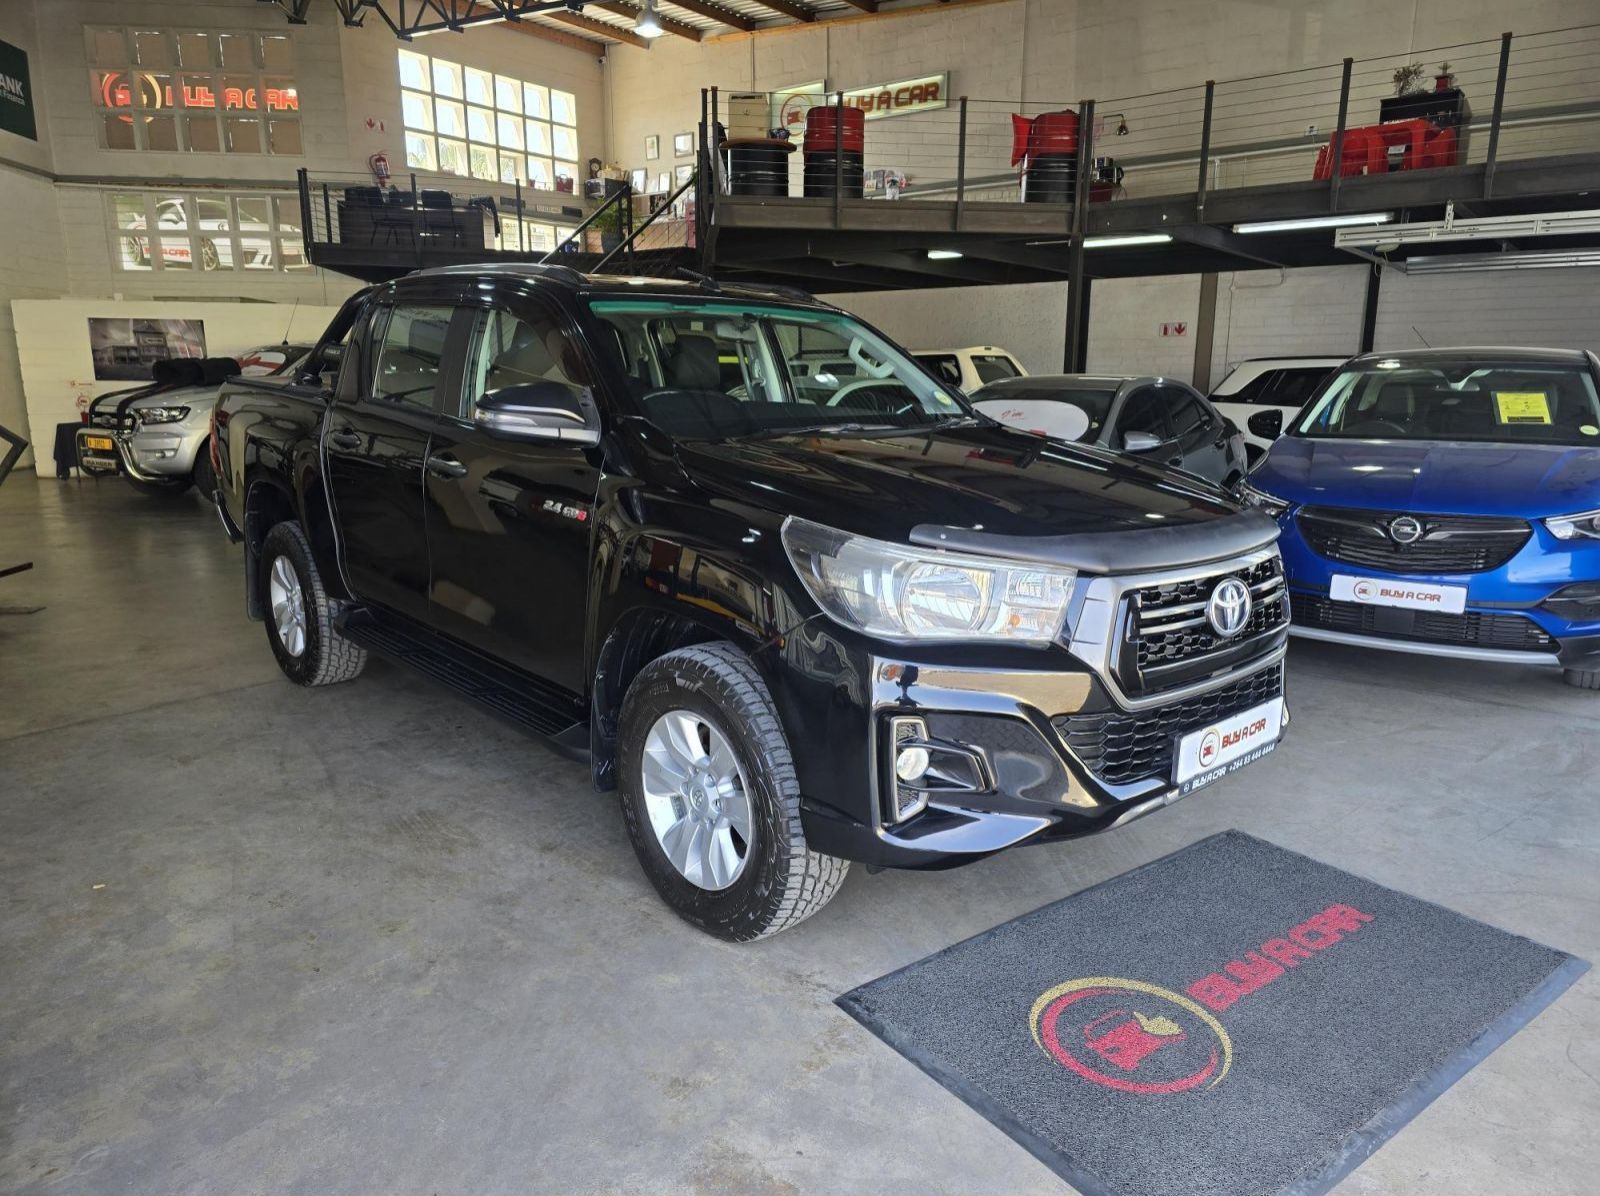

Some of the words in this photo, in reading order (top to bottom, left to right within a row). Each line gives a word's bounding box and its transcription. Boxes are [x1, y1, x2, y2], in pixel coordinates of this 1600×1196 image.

[224, 87, 243, 109] A
[877, 91, 891, 111] A
[895, 82, 940, 107] CAR
[1380, 588, 1405, 599] BUY
[1406, 591, 1414, 599] A
[1416, 592, 1442, 602] CAR
[1222, 728, 1242, 749] BUY
[1241, 726, 1249, 740] A
[1249, 717, 1267, 737] CAR
[1192, 774, 1207, 790] BUY
[1206, 772, 1213, 783] A
[1212, 766, 1227, 780] CAR
[1185, 949, 1285, 1013] BUY
[1260, 938, 1313, 969] A
[1288, 903, 1376, 951] CAR
